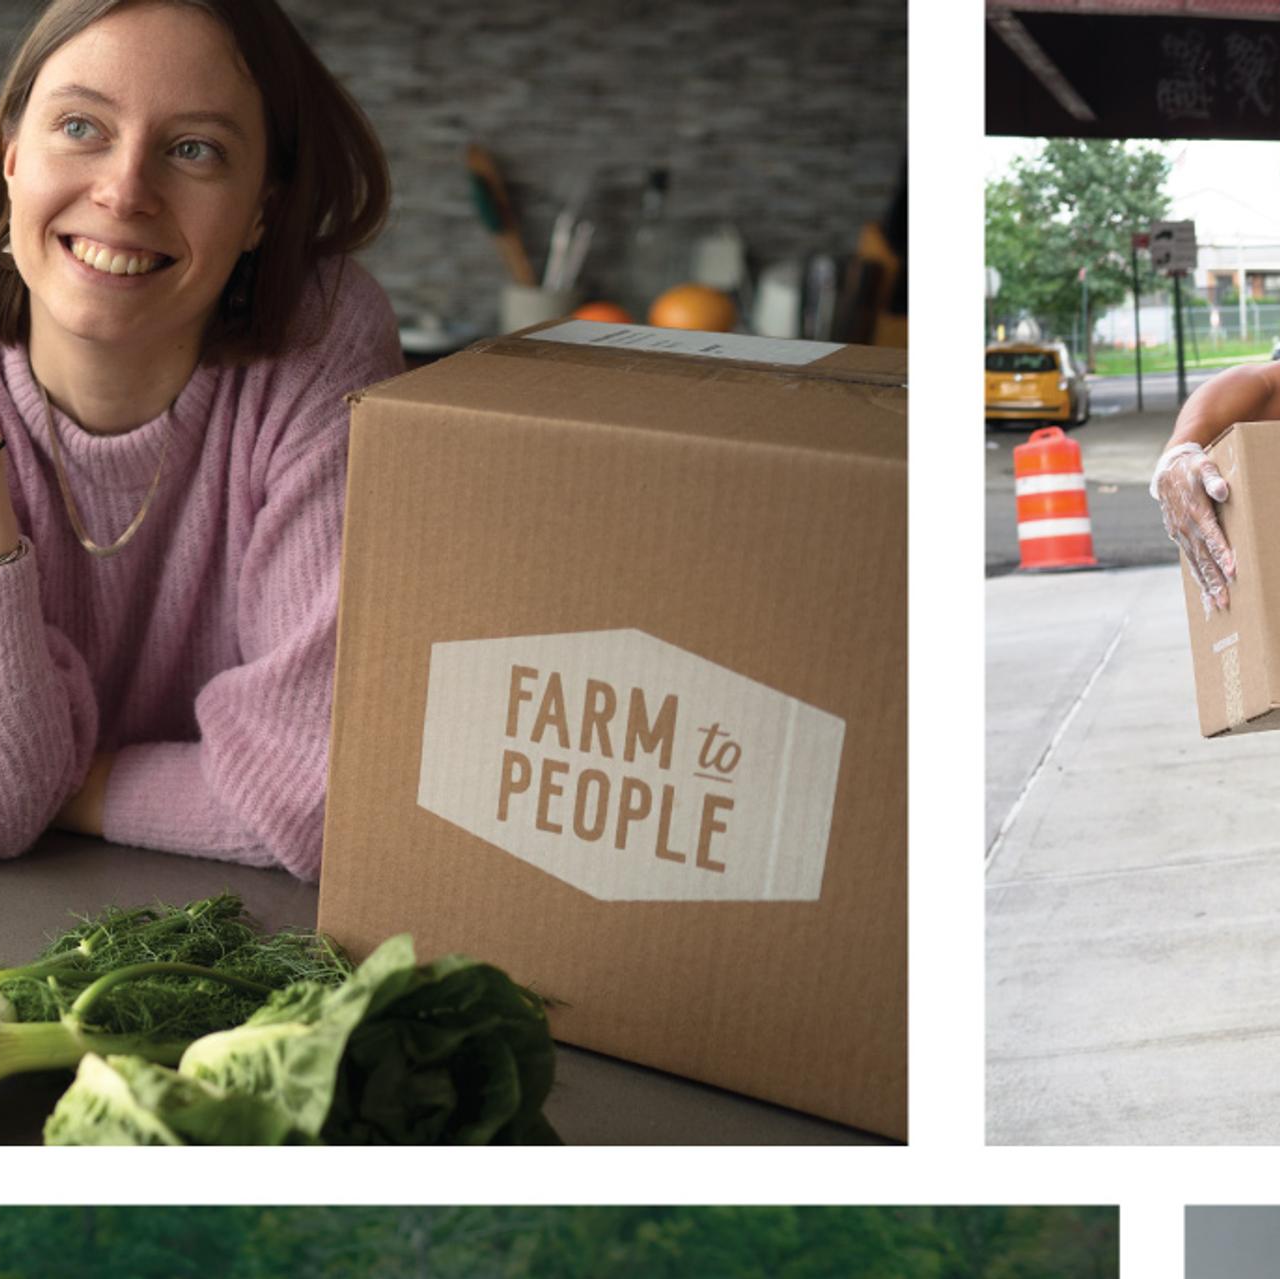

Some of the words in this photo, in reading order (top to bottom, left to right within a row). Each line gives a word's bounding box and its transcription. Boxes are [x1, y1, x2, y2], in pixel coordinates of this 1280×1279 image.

[505, 664, 679, 770] FARM
[695, 722, 743, 776] to
[496, 748, 736, 874] PEOPLE
